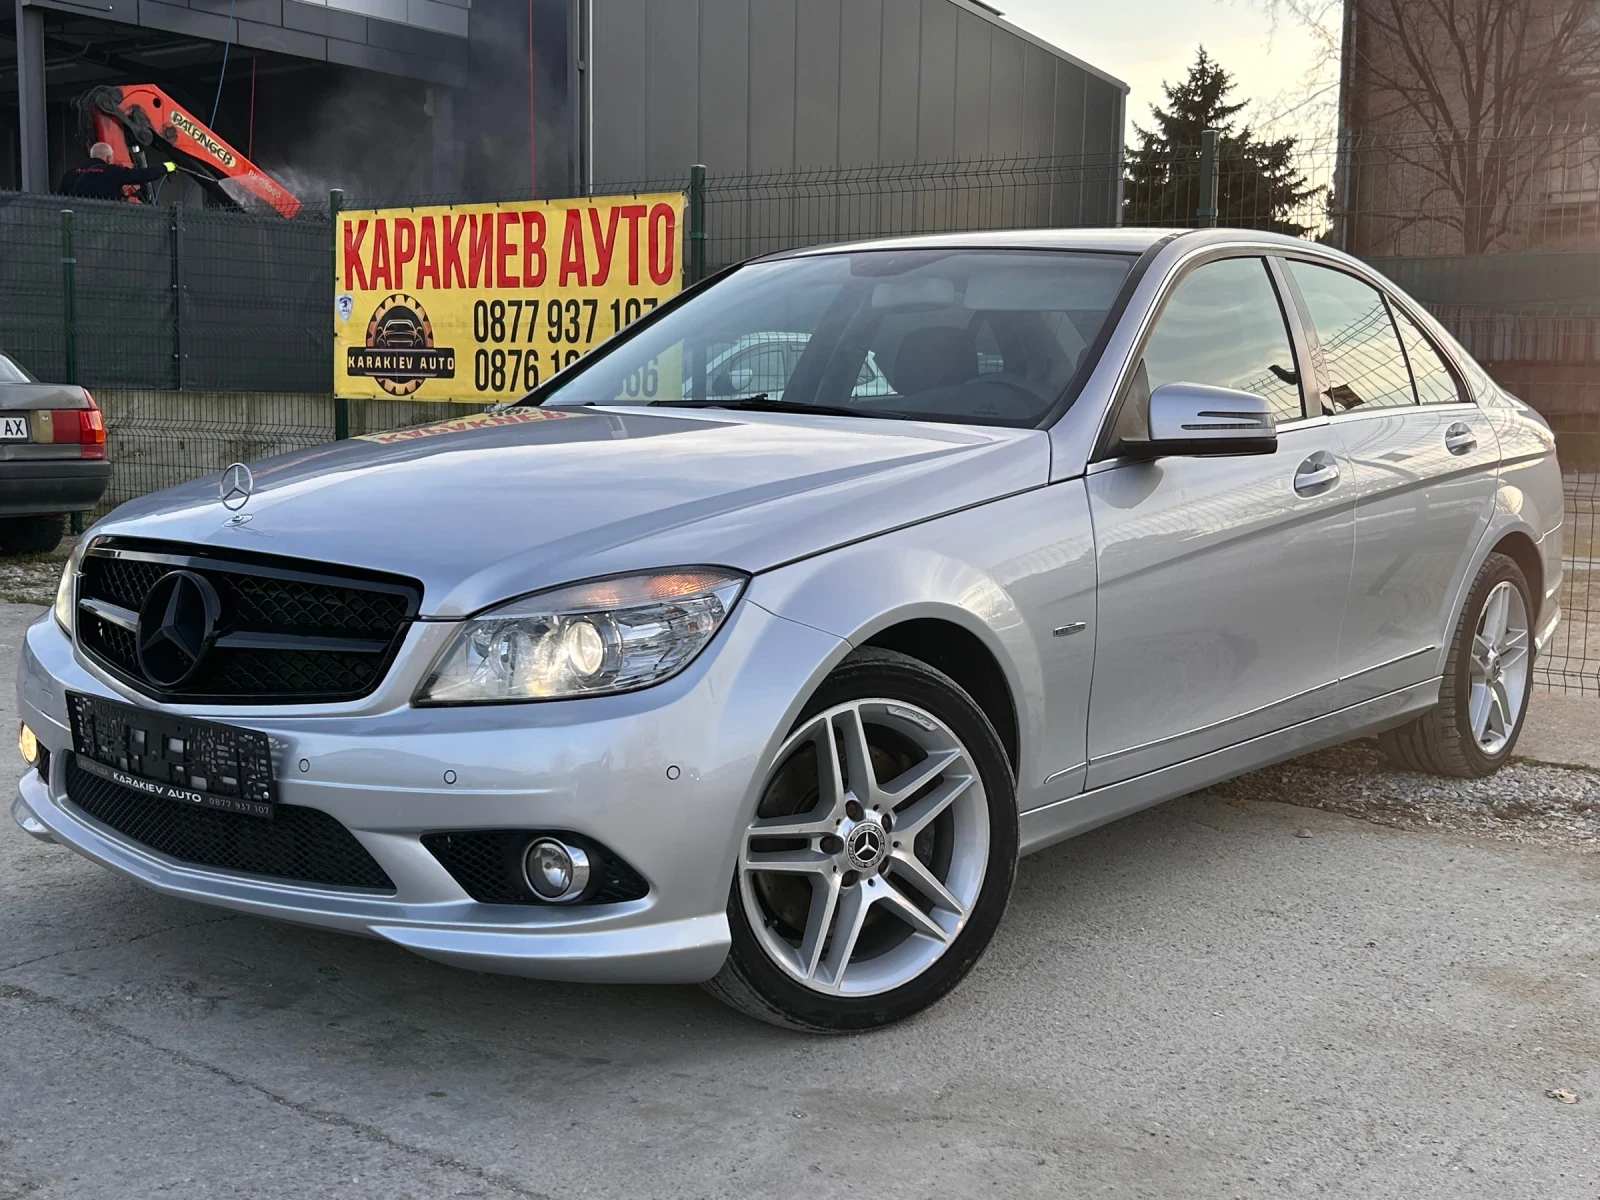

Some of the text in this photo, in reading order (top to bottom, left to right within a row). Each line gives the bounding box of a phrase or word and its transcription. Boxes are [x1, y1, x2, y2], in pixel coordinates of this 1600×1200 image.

[171, 111, 233, 166] PALFINGER
[343, 203, 676, 291] КАРАКИЕВ АУТО
[474, 298, 659, 344] 0877 937 10
[348, 356, 455, 370] KARAKIEV AUTO
[474, 349, 540, 392] 0876
[4, 420, 25, 436] AX
[113, 771, 202, 803] KARAKIEV AUTO
[208, 797, 270, 815] 0877 937 107
